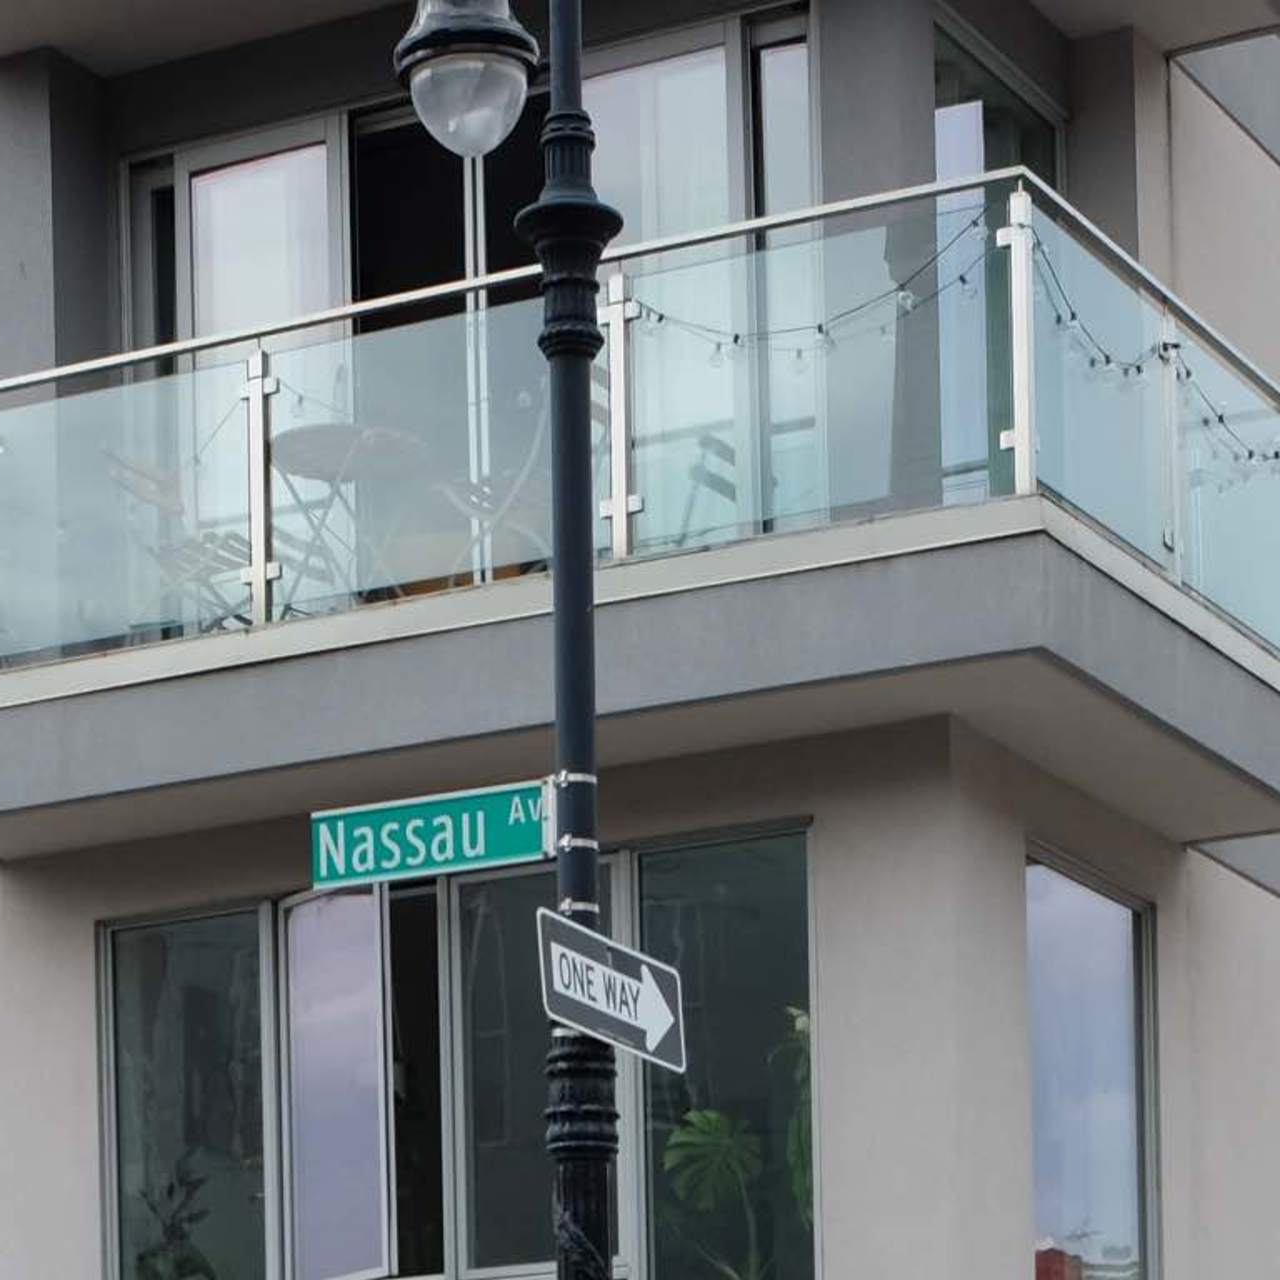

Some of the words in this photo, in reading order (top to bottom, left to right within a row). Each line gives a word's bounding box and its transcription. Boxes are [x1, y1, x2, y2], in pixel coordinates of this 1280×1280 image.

[319, 810, 486, 878] Nassau
[560, 952, 597, 1002] ONE
[602, 972, 640, 1021] WAY
